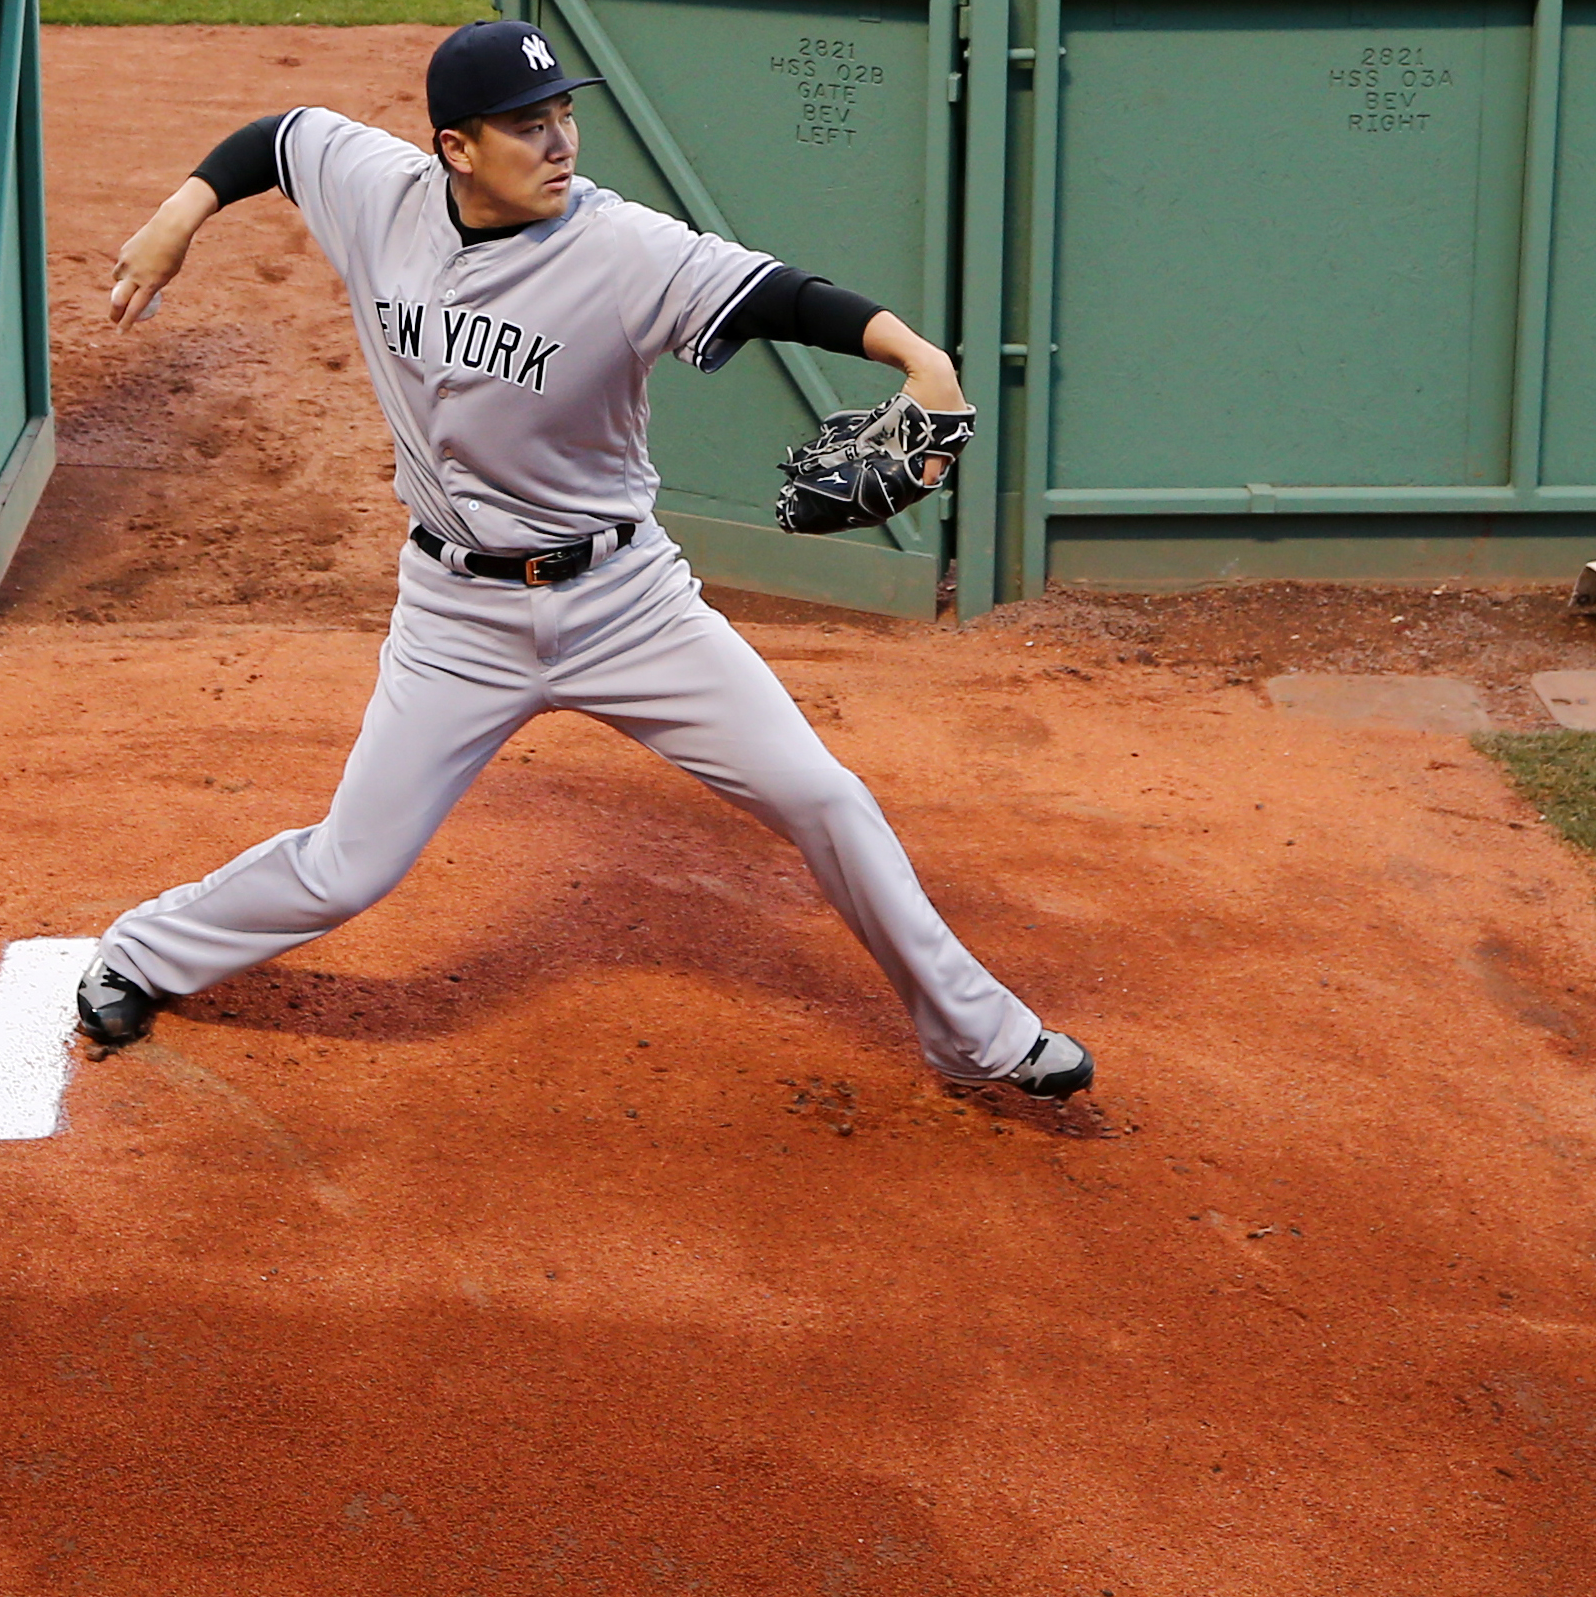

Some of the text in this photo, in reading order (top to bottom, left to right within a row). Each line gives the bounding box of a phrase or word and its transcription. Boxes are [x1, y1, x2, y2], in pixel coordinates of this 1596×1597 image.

[799, 37, 855, 61] 2821
[1361, 47, 1424, 66] 2821
[770, 56, 816, 79] HSS
[1329, 70, 1379, 88] HSS
[798, 81, 856, 104] GATE
[1366, 92, 1417, 110] BEV
[803, 104, 850, 124] BEV
[1348, 114, 1431, 133] RIGHT
[796, 124, 857, 146] LEFT
[441, 307, 566, 396] YORK
